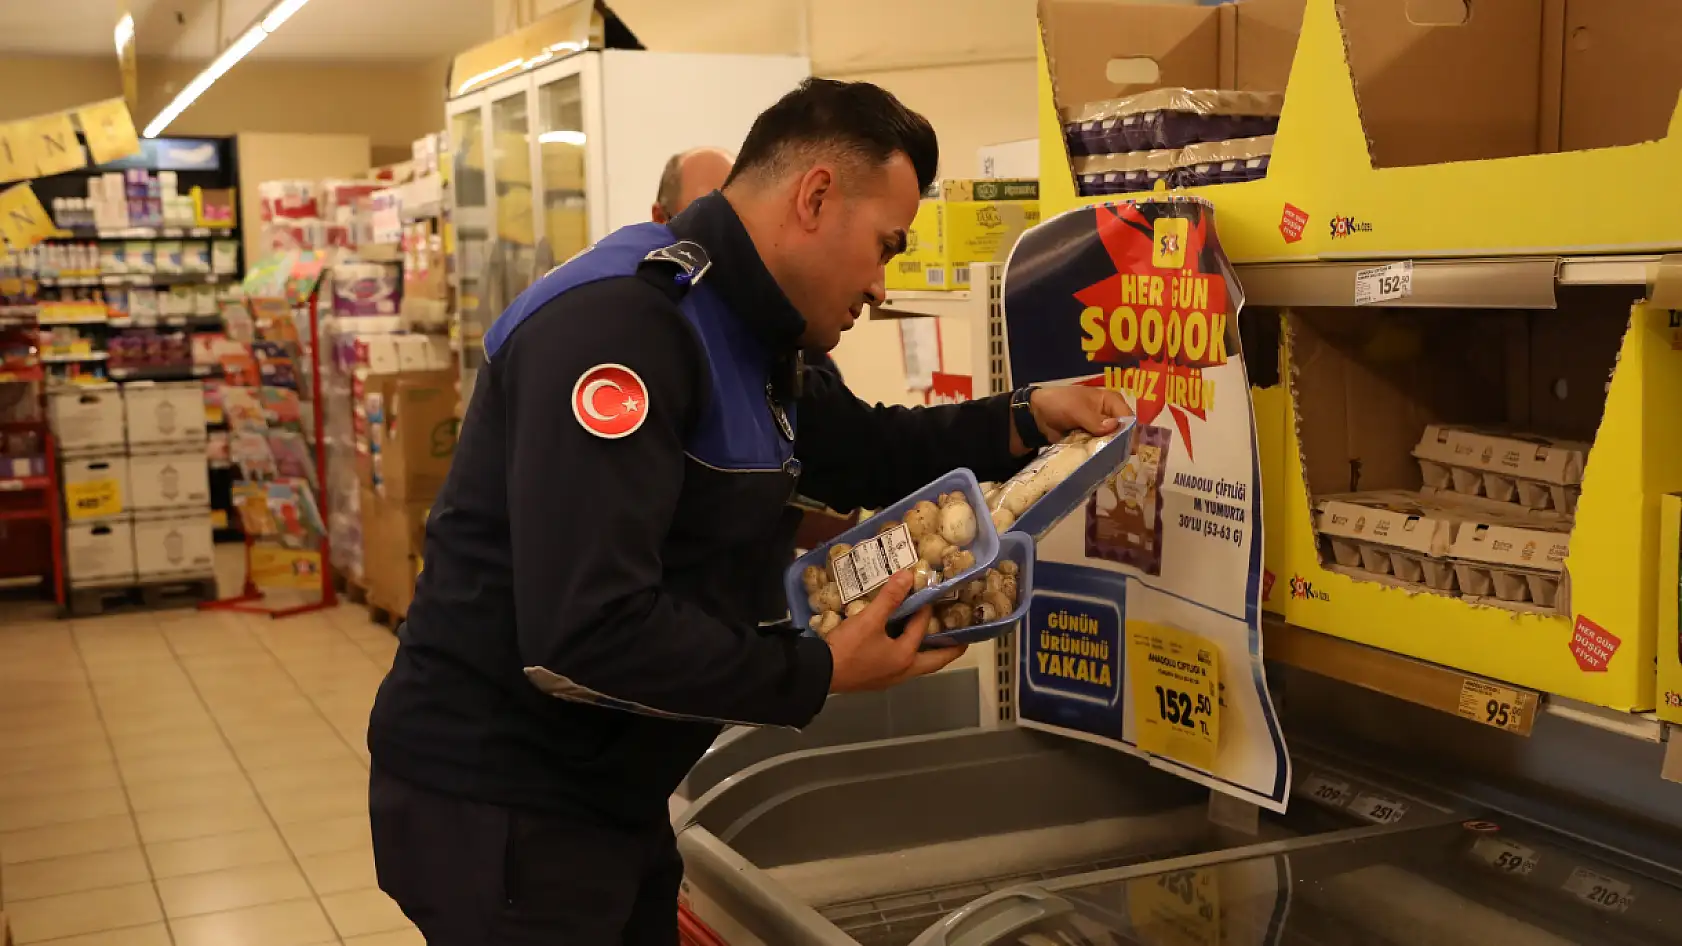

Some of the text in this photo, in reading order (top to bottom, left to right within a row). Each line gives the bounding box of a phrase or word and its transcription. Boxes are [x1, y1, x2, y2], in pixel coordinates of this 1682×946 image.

[1121, 269, 1209, 310] HER GÜN
[1379, 275, 1400, 295] 152
[1080, 306, 1228, 363] ŞOOOOK
[1104, 366, 1215, 412] UCUZ ÜRÜN
[1172, 472, 1246, 502] ANADOLU ÇİFTLİĞİ
[1193, 497, 1245, 523] M YUMURTA
[1178, 513, 1202, 532] 30'LU
[1203, 519, 1231, 541] (53-63
[1047, 610, 1098, 636] GÜNÜN
[1578, 623, 1595, 639] HER
[1040, 629, 1109, 660] ÜRÜNÜNÜ
[1036, 651, 1112, 688] YAKALA
[1155, 684, 1195, 729] 152
[1486, 699, 1511, 726] 95
[1370, 804, 1393, 820] 251
[1495, 851, 1522, 871] 59
[1589, 885, 1619, 906] 210
